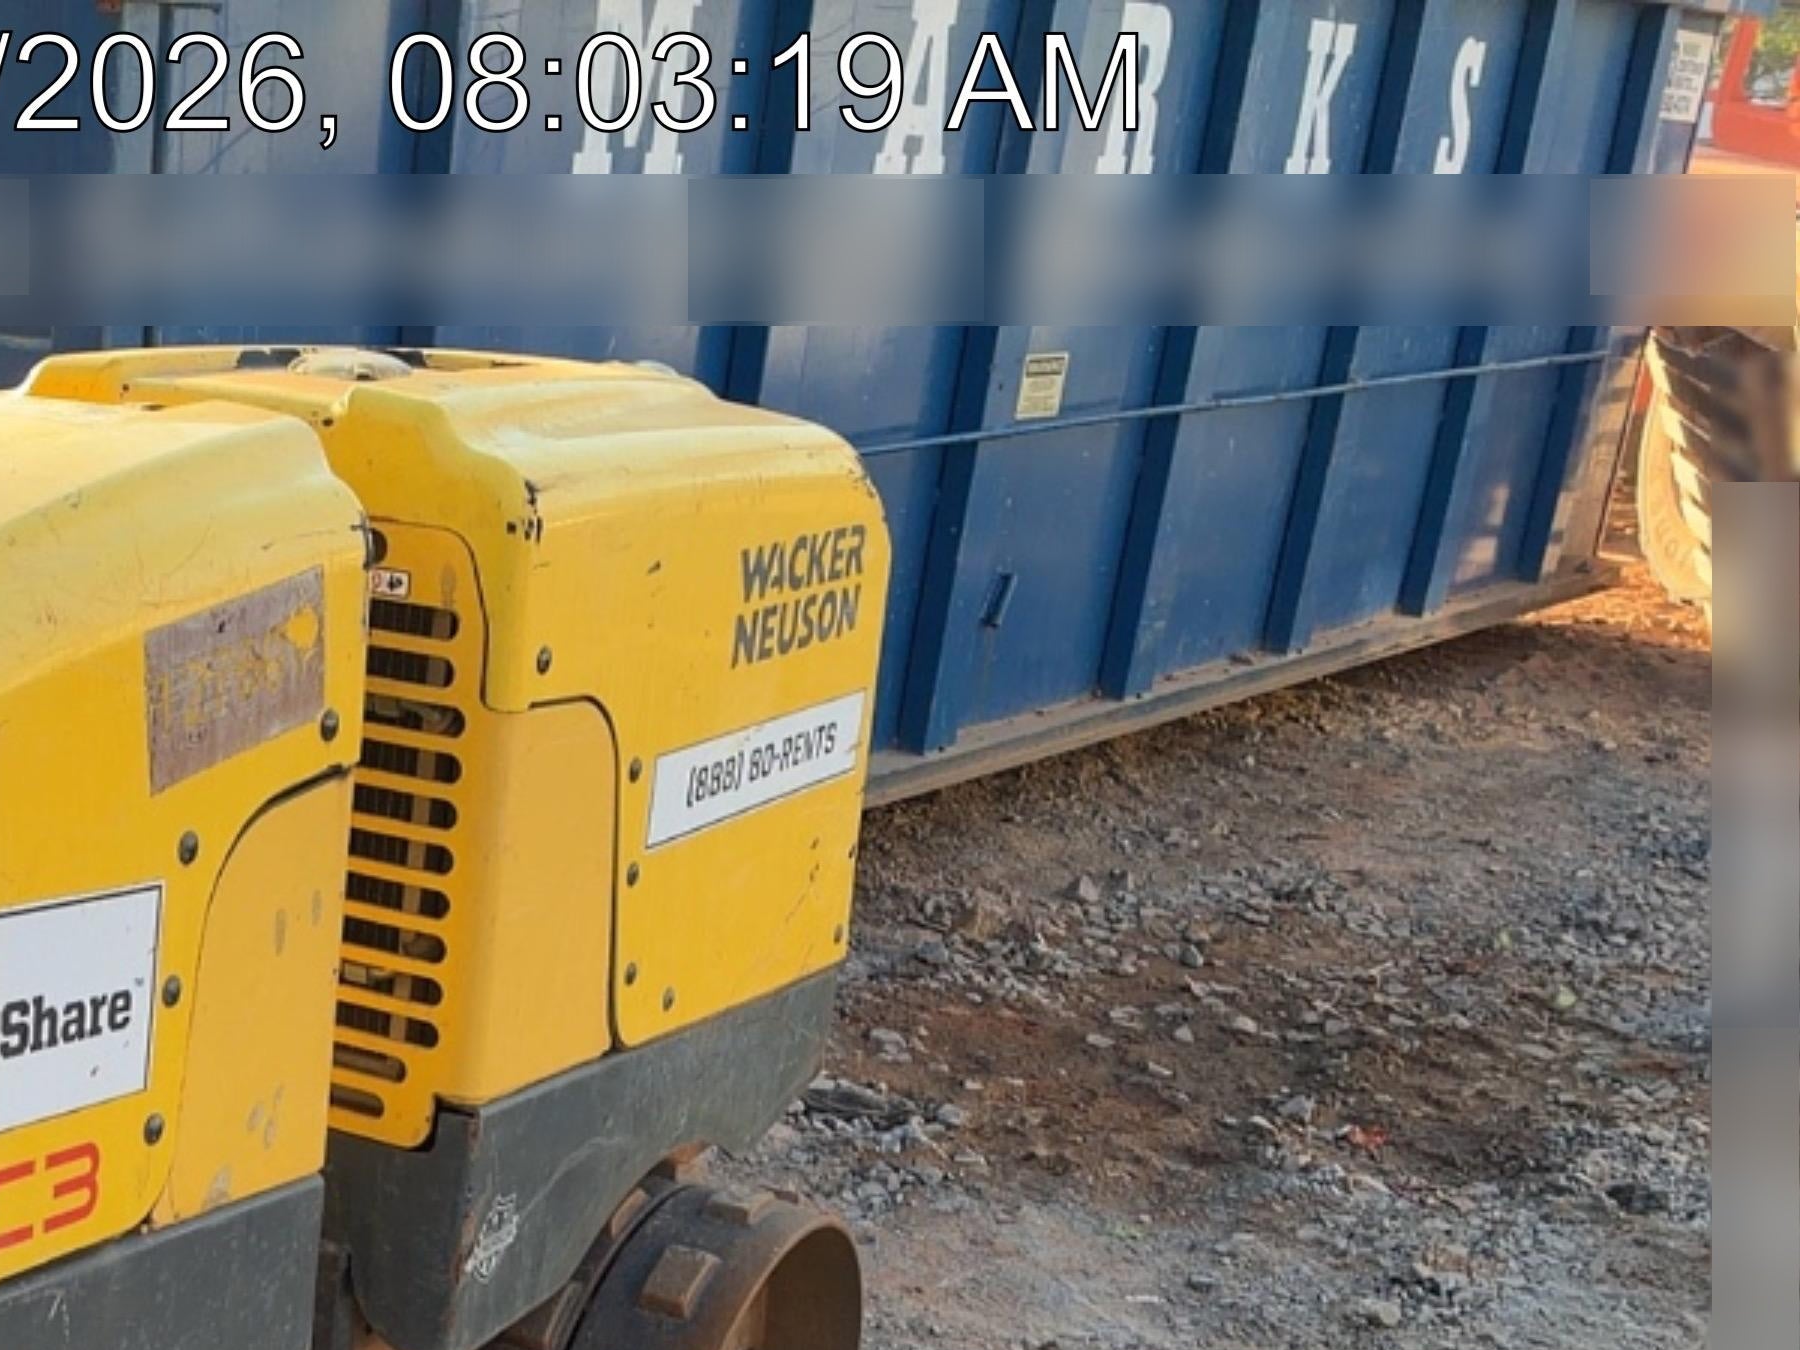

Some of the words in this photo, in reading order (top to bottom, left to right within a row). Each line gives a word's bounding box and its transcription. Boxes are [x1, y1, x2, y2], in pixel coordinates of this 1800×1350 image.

[741, 524, 867, 603] WACKER
[731, 583, 861, 670] NEUSON
[686, 750, 744, 808] (888)
[749, 721, 838, 783] 80-RENTS
